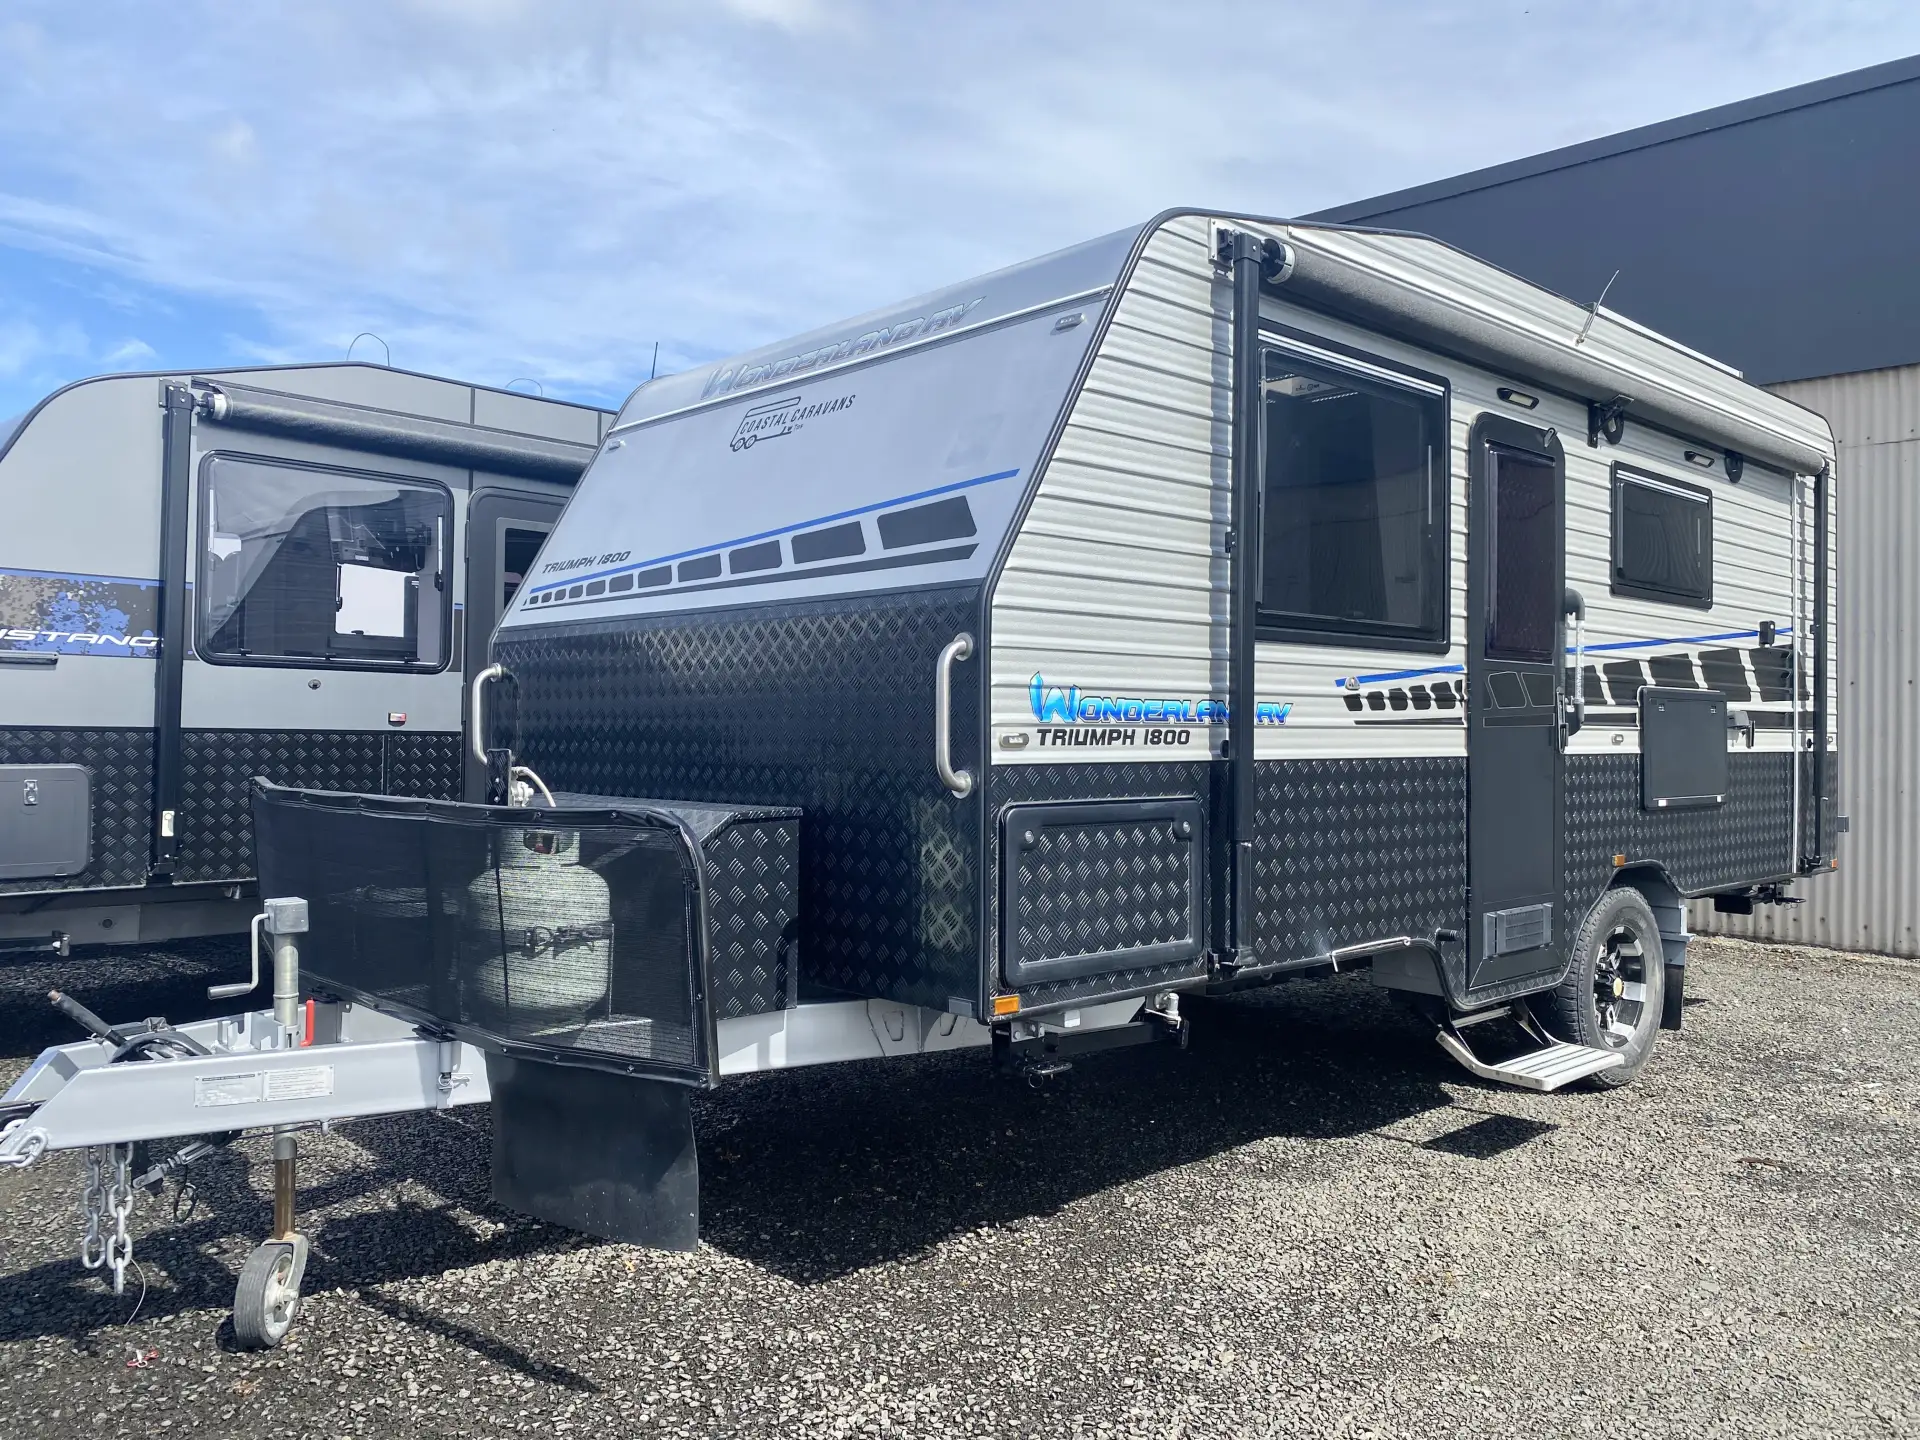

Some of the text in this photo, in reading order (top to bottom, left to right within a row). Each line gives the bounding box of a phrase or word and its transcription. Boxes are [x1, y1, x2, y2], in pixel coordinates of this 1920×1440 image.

[700, 317, 926, 400] WONDERLAND
[740, 394, 856, 435] COASTAL CARAVANS
[542, 551, 632, 574] TRIUMPH 1800
[1028, 671, 1293, 725] WONDERLAN RV
[1037, 729, 1190, 746] TRIUMPH 1800
